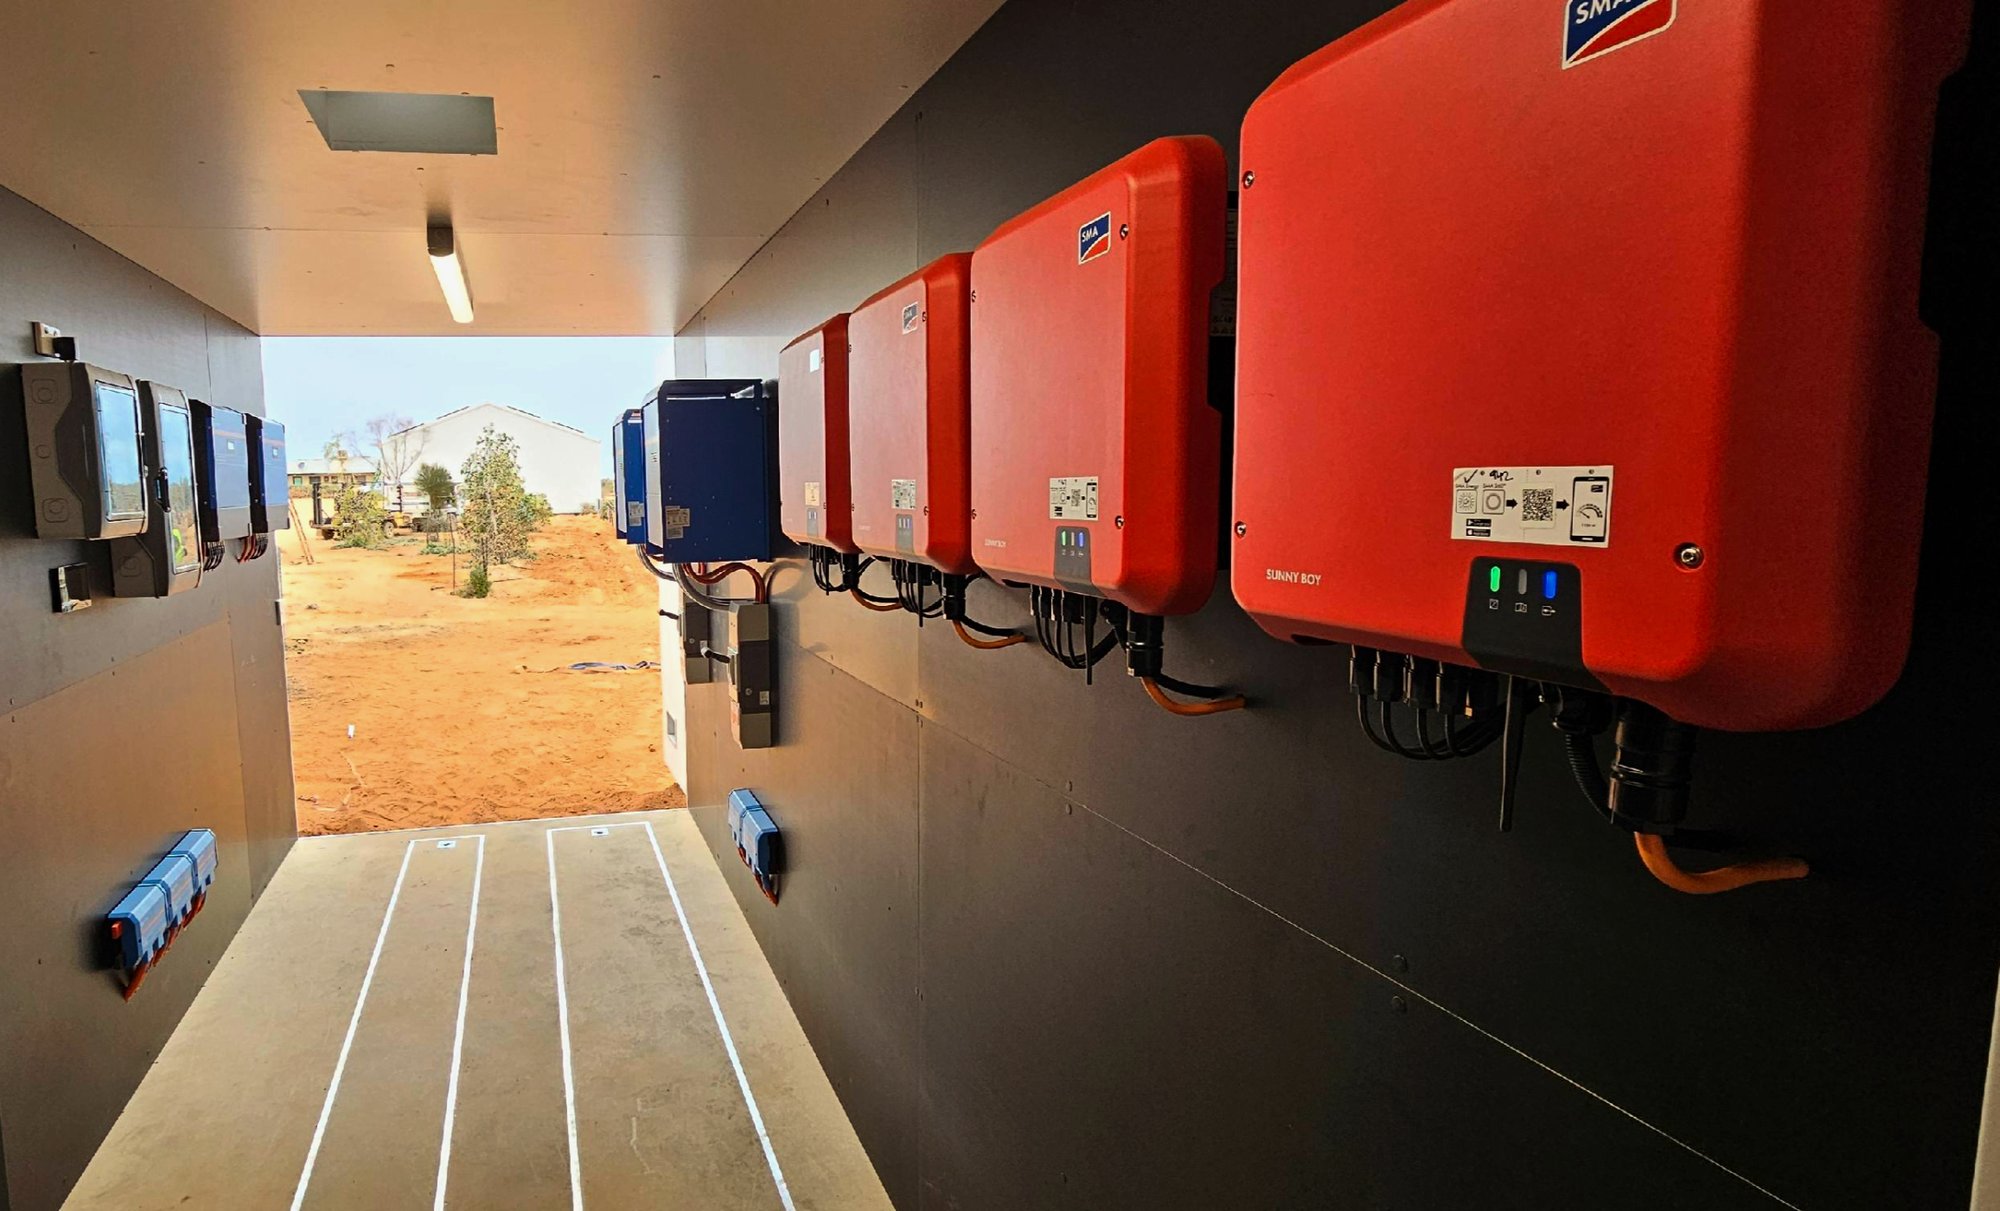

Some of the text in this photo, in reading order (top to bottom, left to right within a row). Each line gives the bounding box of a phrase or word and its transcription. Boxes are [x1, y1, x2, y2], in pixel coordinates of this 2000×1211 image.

[1082, 224, 1098, 242] SMA
[1266, 568, 1321, 586] SUNNY BOY
